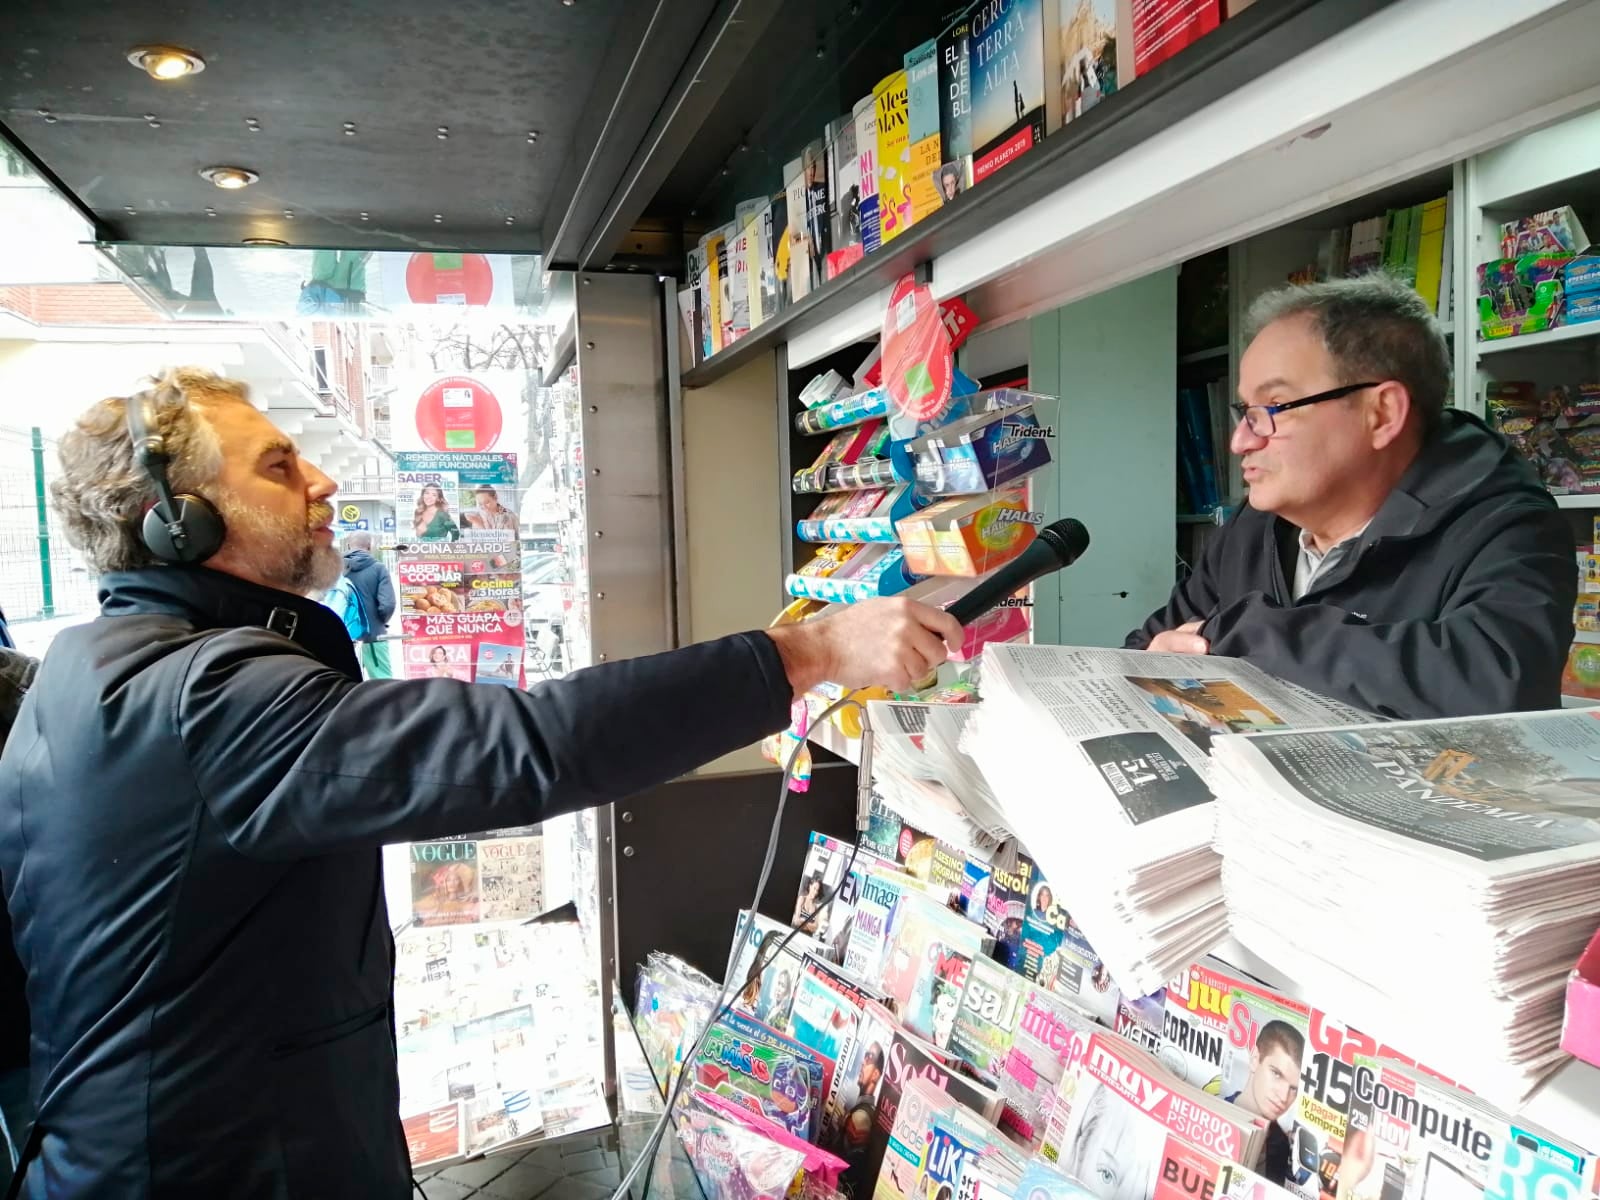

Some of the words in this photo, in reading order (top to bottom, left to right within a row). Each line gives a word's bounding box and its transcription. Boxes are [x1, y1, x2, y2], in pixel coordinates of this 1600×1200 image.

[973, 0, 1013, 38] CERC
[977, 12, 1024, 67] TERRA
[946, 45, 958, 65] EL
[984, 50, 1020, 96] ALTA
[994, 148, 1014, 165] PLANETA
[1003, 423, 1056, 439] Trident
[405, 453, 450, 462] REMEDIOS
[452, 454, 503, 462] NATURALES
[439, 462, 491, 470] FUNCIONAN
[397, 473, 442, 483] SABER
[999, 508, 1044, 524] HALLS
[467, 542, 512, 554] TARDE
[400, 564, 439, 573] SABER
[408, 573, 462, 582] COCINAR
[472, 579, 514, 588] Cocina
[487, 587, 520, 596] horas
[427, 613, 455, 624] MÁS
[457, 613, 501, 624] GUAPA
[425, 624, 453, 636] QUE
[457, 622, 504, 633] NUNCA
[409, 646, 469, 662] CLRA
[1371, 760, 1555, 828] PANDEMIA
[412, 842, 477, 861] VOGUE
[483, 843, 527, 859] VOGUE
[935, 849, 963, 871] ASESINO
[994, 867, 1029, 896] Astrol
[855, 909, 883, 938] MANGA
[1163, 1009, 1223, 1067] CORINN
[721, 1044, 771, 1086] MASKS
[1089, 1043, 1168, 1113] muy
[1171, 1094, 1218, 1132] NEURO
[1310, 1099, 1339, 1126] pagar
[1354, 1065, 1493, 1162] Compute
[1166, 1110, 1214, 1148] PSICO
[1304, 1110, 1346, 1138] compras
